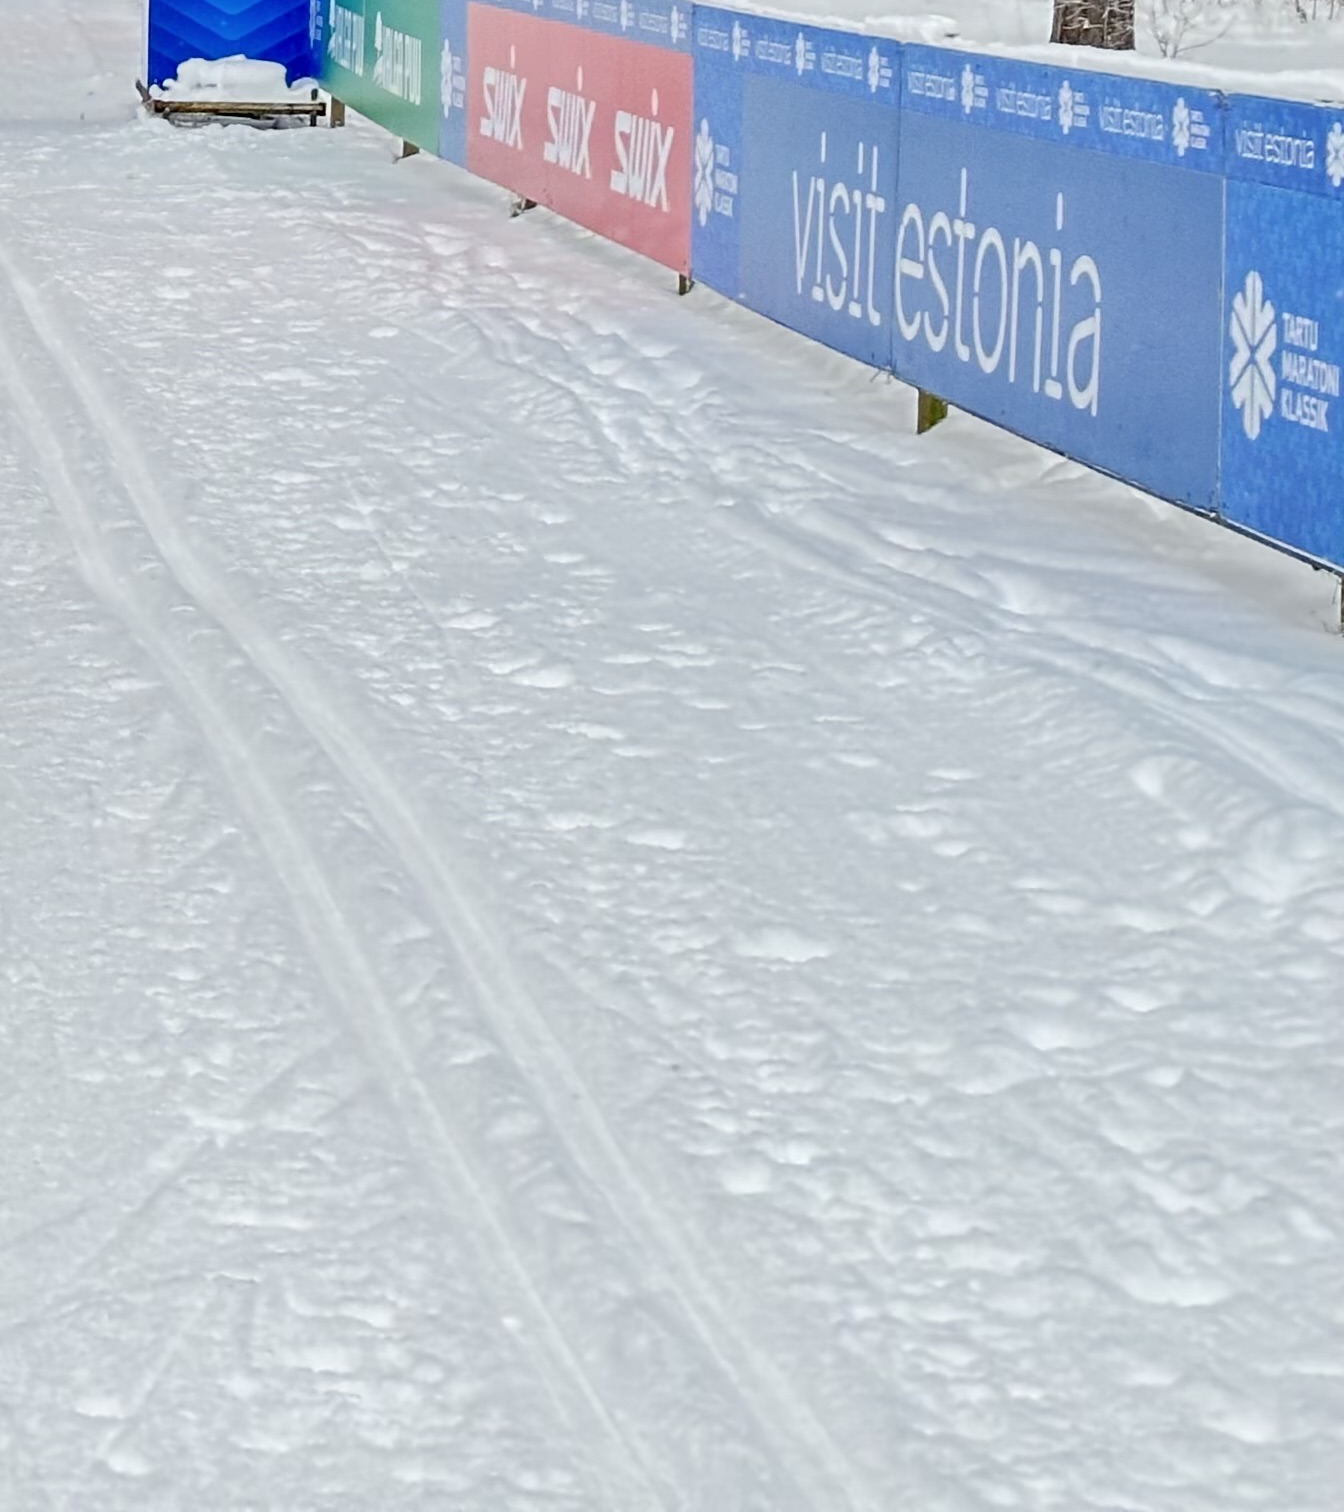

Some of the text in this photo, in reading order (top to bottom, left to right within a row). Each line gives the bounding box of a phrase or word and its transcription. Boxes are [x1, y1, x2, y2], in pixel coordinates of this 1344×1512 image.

[1235, 120, 1265, 160] visit
[1265, 126, 1315, 169] estonia
[792, 131, 1103, 418] visit estonia
[1281, 312, 1320, 352] TARTU
[1280, 388, 1329, 433] KLASSIK
